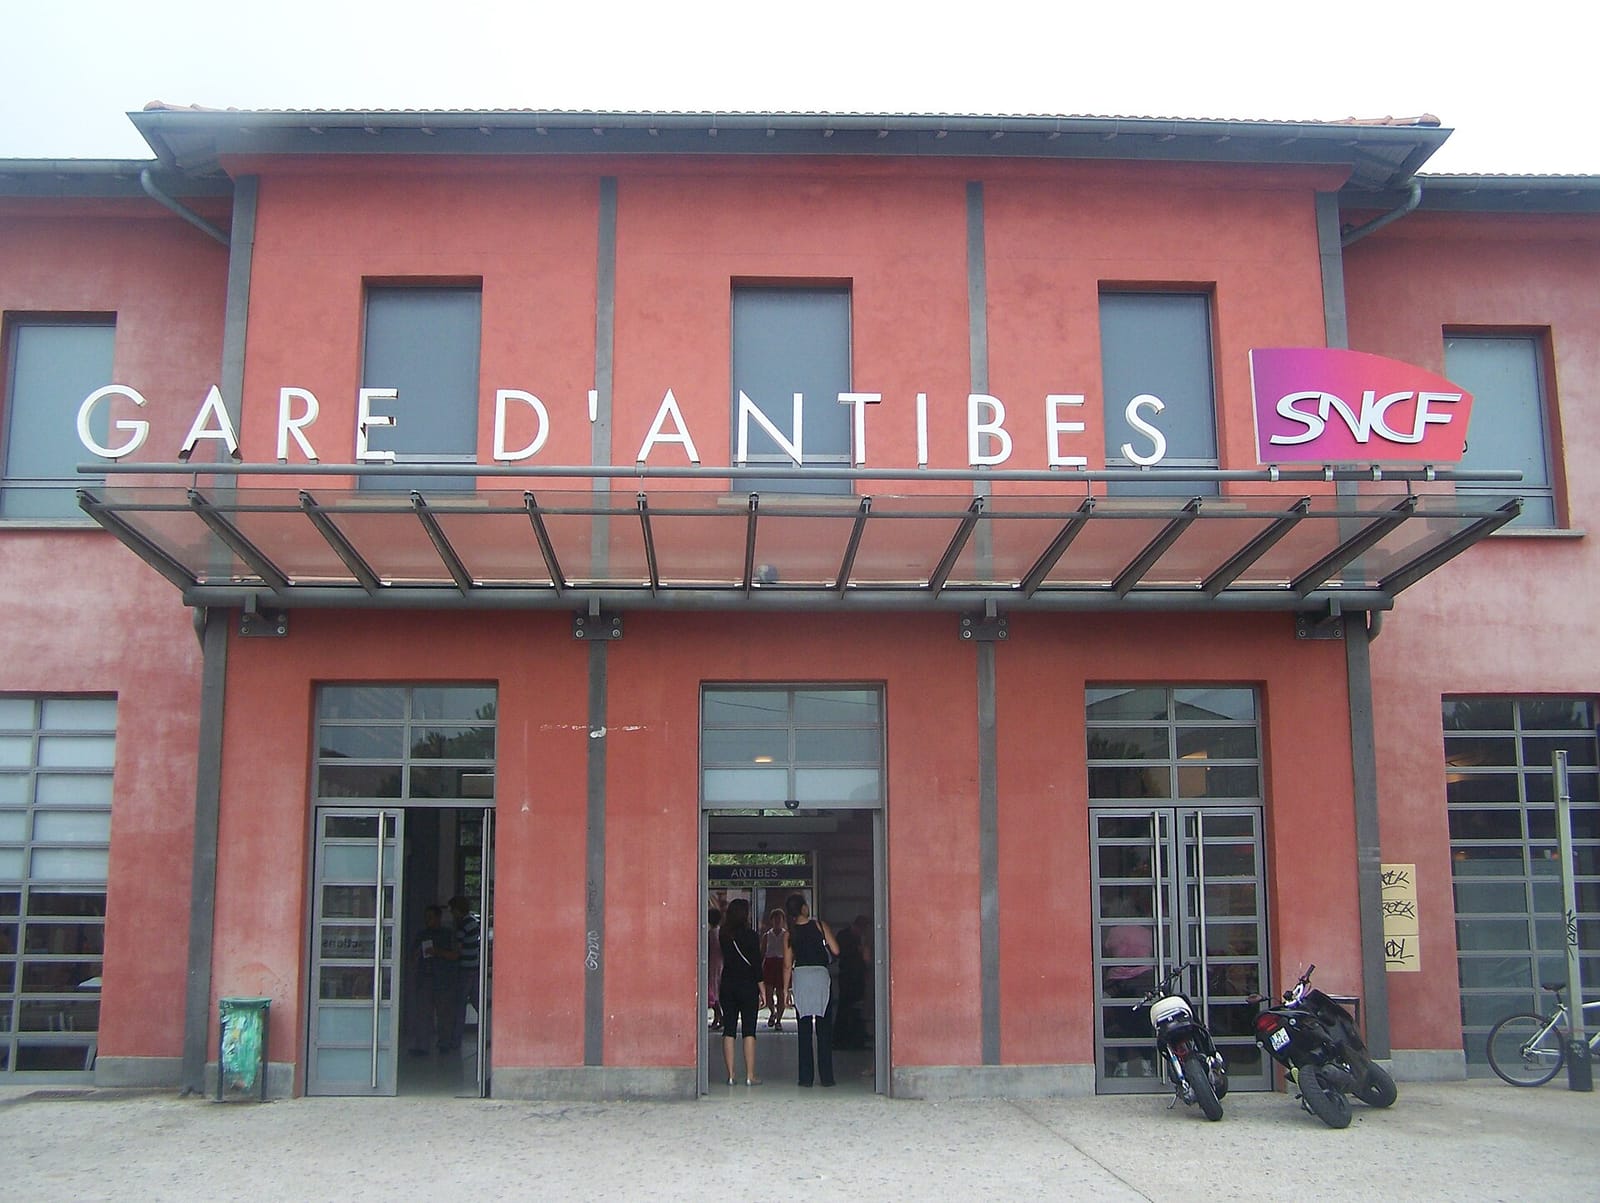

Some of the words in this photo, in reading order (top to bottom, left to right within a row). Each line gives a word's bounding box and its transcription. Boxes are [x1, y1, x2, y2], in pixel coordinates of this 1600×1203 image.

[77, 384, 398, 460] GARE
[494, 388, 1166, 466] D'ANTIBES
[1269, 390, 1462, 445] SNCF
[731, 868, 778, 878] ANTIBES
